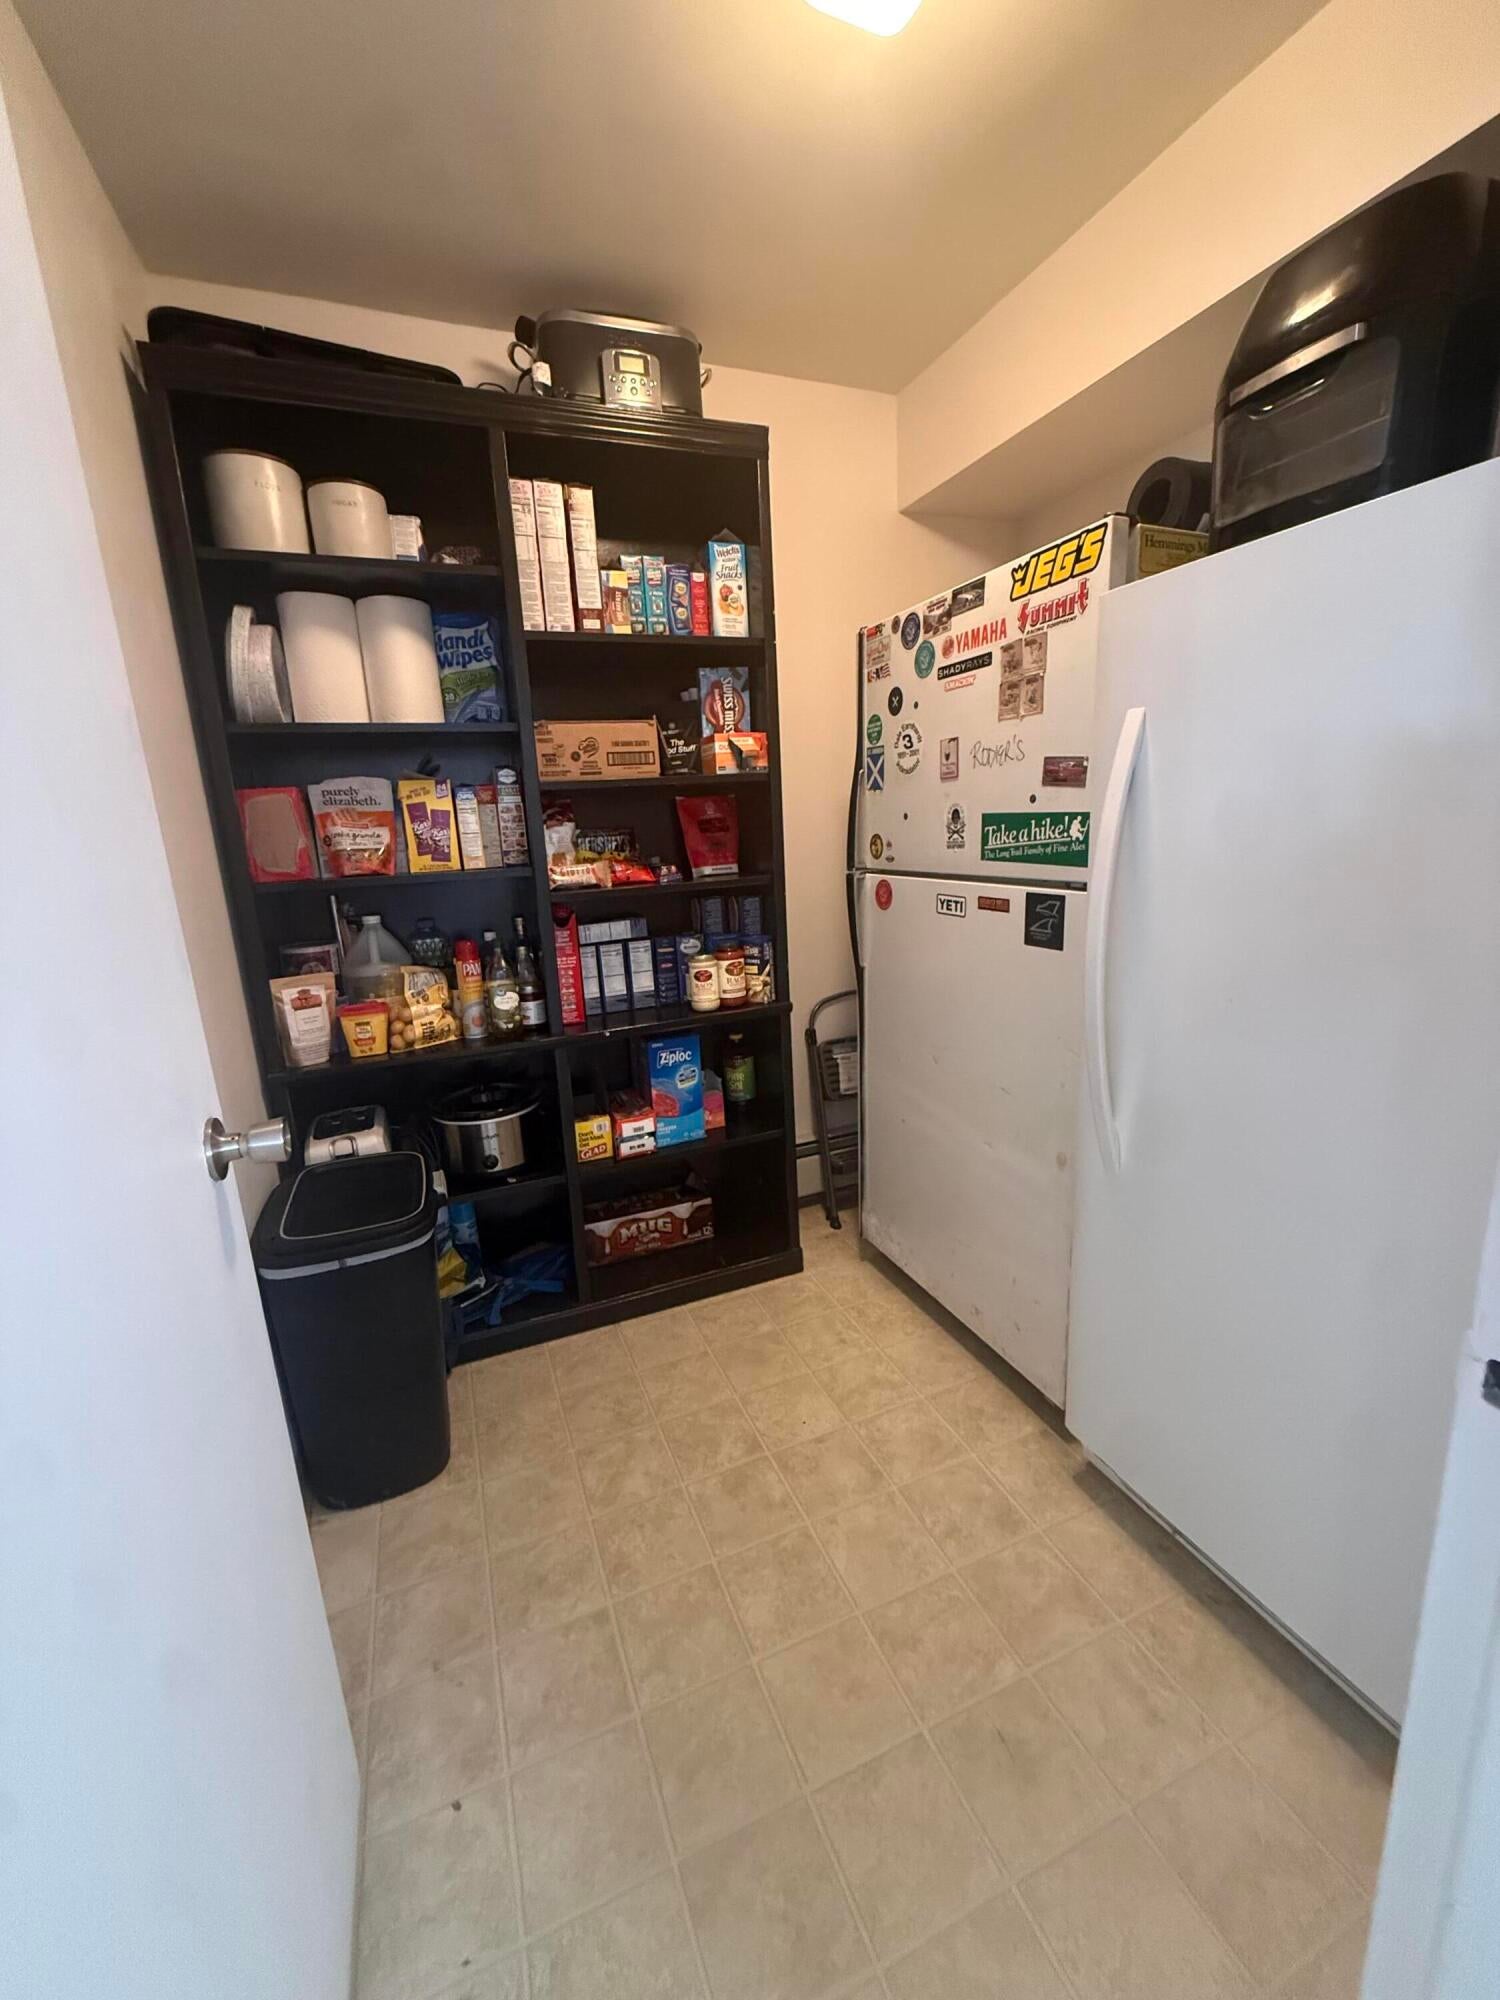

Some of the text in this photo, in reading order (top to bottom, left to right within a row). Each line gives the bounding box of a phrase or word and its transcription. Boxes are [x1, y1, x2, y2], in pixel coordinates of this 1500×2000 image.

[721, 563, 739, 573] Fruit
[1010, 523, 1107, 601] JEG'S
[955, 617, 1008, 654] YAMAHA
[670, 739, 685, 747] The
[677, 743, 697, 753] Stuff
[902, 734, 913, 749] 3
[321, 785, 359, 798] purely
[322, 795, 382, 806] elizabeth.
[984, 824, 1017, 847] Take
[1018, 827, 1028, 842] a
[1030, 815, 1068, 842] hike!
[984, 850, 996, 859] The
[996, 849, 1010, 859] Long
[1024, 845, 1044, 856] Family
[1053, 843, 1068, 853] Fine
[1070, 841, 1086, 851] Ales
[938, 898, 964, 914] YETI
[660, 1050, 692, 1067] Ziploc
[581, 1144, 606, 1159] GLAD
[619, 1217, 673, 1243] MUG
